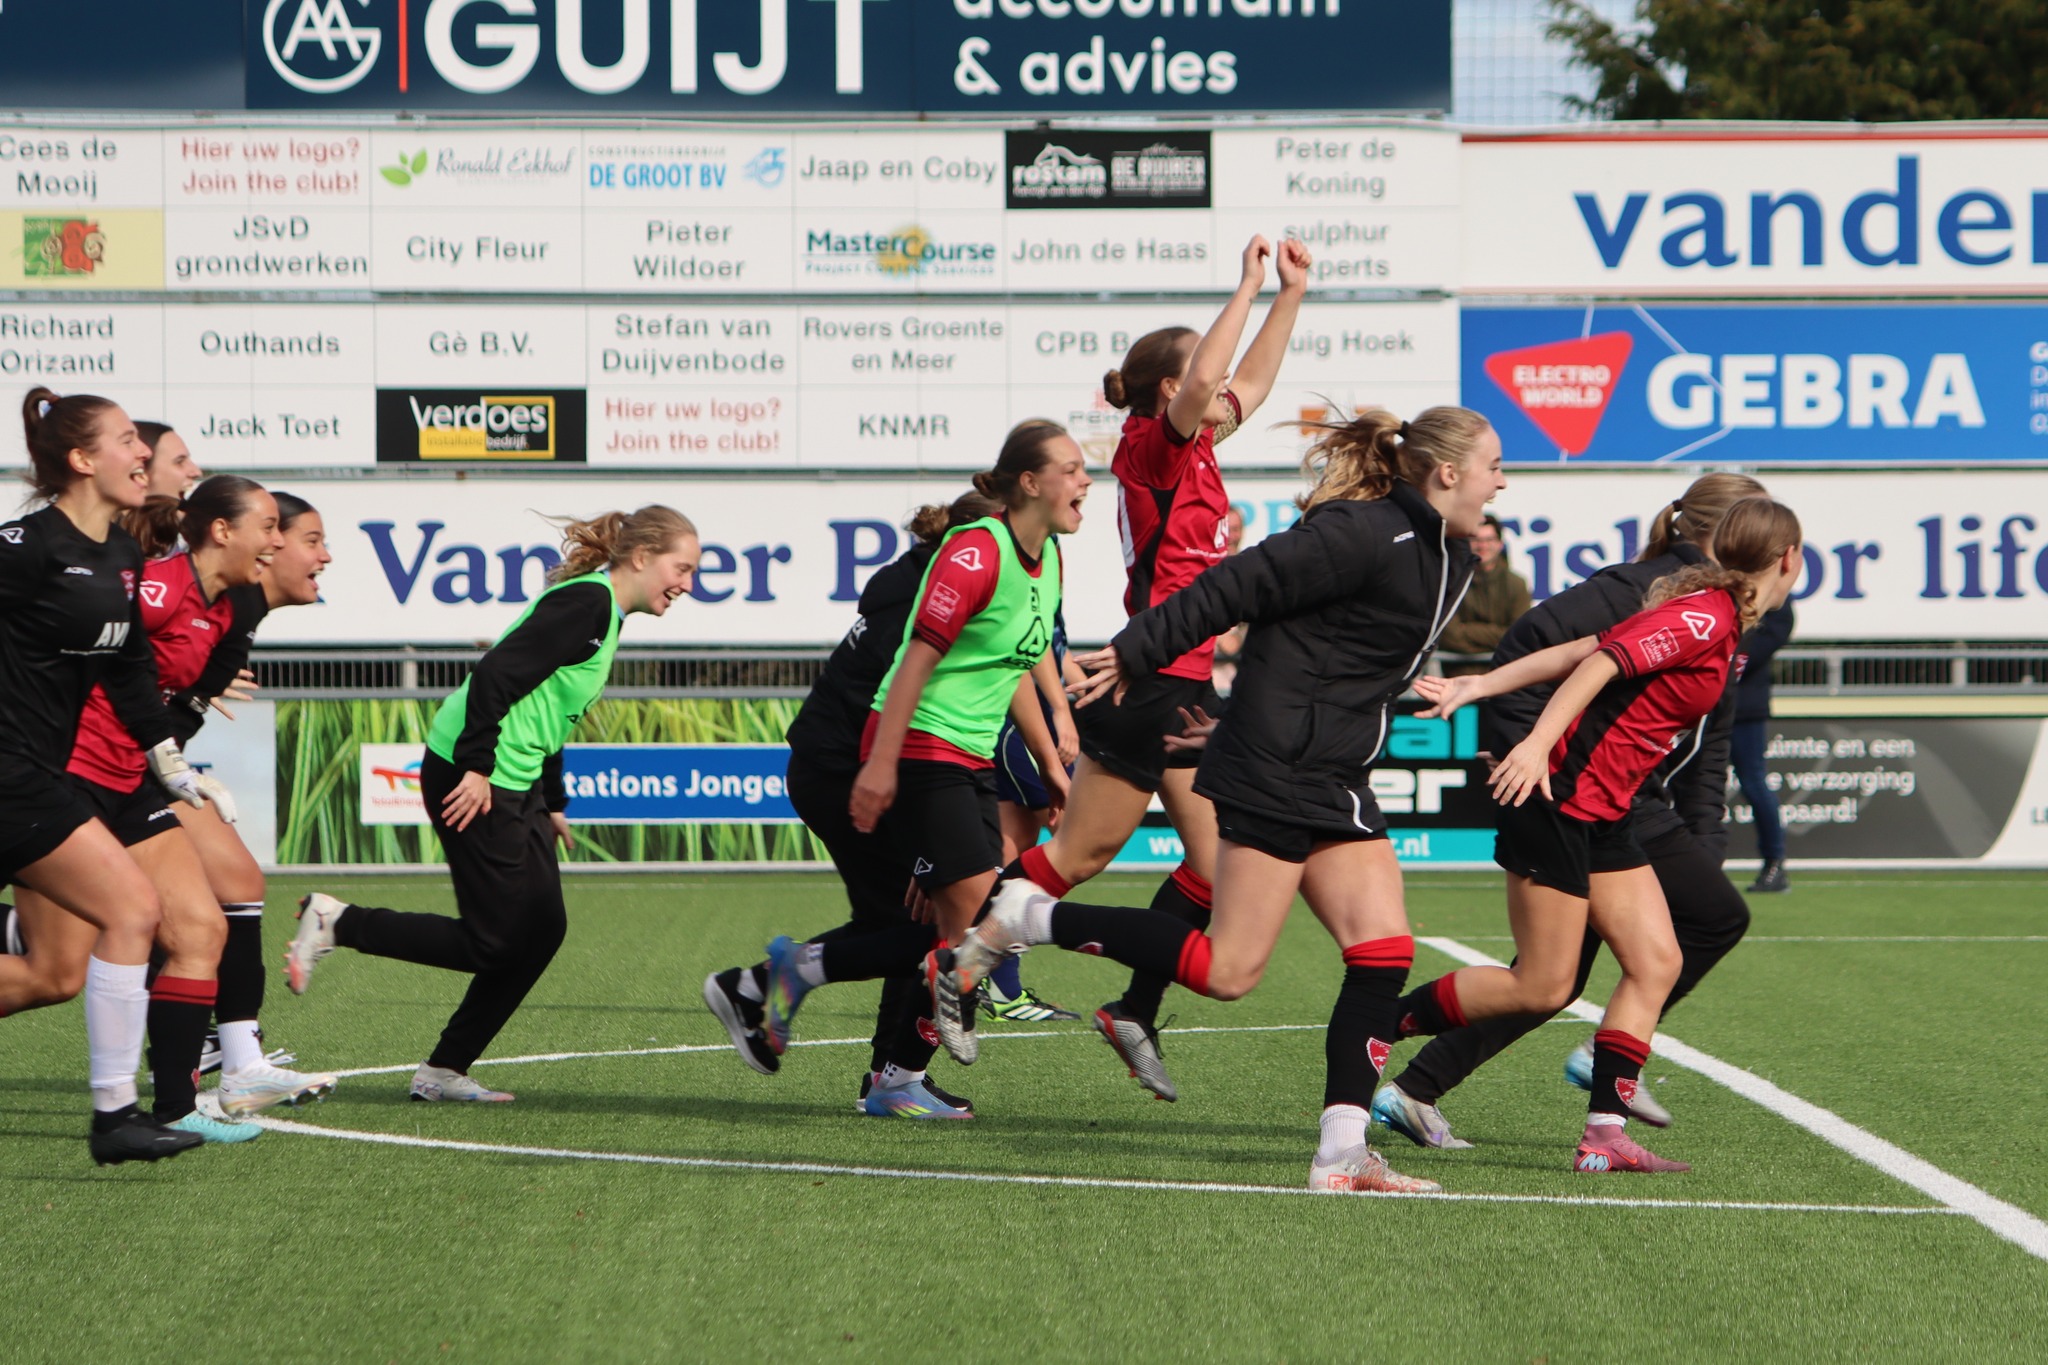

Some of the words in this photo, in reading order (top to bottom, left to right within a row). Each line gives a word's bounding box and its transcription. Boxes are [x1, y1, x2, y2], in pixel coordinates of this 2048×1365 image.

[424, 0, 868, 94] GUIJT
[953, 37, 1000, 95] &
[1019, 35, 1238, 95] advies
[0, 136, 70, 160] Cees
[82, 135, 117, 160] de
[181, 137, 233, 160] Hier
[243, 144, 279, 160] uw
[289, 137, 360, 166] logo?
[1275, 137, 1350, 160] Peter
[1361, 137, 1397, 160] de
[182, 170, 237, 191] Join
[246, 171, 287, 191] the
[296, 170, 359, 191] club!
[589, 163, 616, 188] DE
[623, 163, 693, 188] GROOT
[699, 163, 727, 188] BV
[801, 155, 869, 183] Jaap
[880, 162, 913, 178] en
[923, 155, 998, 184] Coby
[17, 171, 97, 196] Mooij
[1286, 172, 1387, 199] Koning
[234, 215, 309, 240] JSvD
[646, 219, 733, 244] Pieter
[1283, 219, 1390, 247] sulphur
[406, 236, 464, 263] City
[476, 236, 549, 260] Fleur
[1012, 239, 1082, 262] John
[1091, 239, 1127, 262] de
[1137, 239, 1208, 262] Haas
[176, 250, 368, 281] grondwerken
[633, 255, 745, 279] Wildoer
[0, 314, 114, 339] Richard
[615, 312, 709, 338] Stefan
[722, 319, 772, 338] van
[803, 316, 893, 340] Rovers
[901, 316, 1005, 340] Groente
[200, 330, 341, 356] Outhands
[480, 331, 535, 356] B.V.
[1035, 330, 1099, 355] CPB
[1288, 328, 1332, 358] uig
[1341, 328, 1416, 353] Hoek
[0, 349, 115, 375] Orizand
[603, 348, 787, 377] Duijvenbode
[851, 352, 883, 371] en
[891, 349, 957, 371] Meer
[1512, 364, 1611, 388] ELECTRO
[1521, 386, 1604, 409] WORLD
[1646, 352, 1987, 428] GEBRA
[605, 397, 656, 422] Hier
[665, 403, 701, 422] uw
[710, 397, 781, 427] logo?
[200, 413, 267, 438] Jack
[278, 413, 341, 438] Toet
[858, 413, 951, 438] KNMR
[606, 431, 660, 456] Join
[669, 431, 710, 456] the
[717, 431, 780, 456] club!
[1763, 733, 1830, 758] uimte
[1833, 738, 1866, 758] en
[1869, 738, 1916, 758] een
[563, 767, 678, 798] tations
[1785, 765, 1917, 797] verzorging
[1778, 796, 1858, 829] paard!
